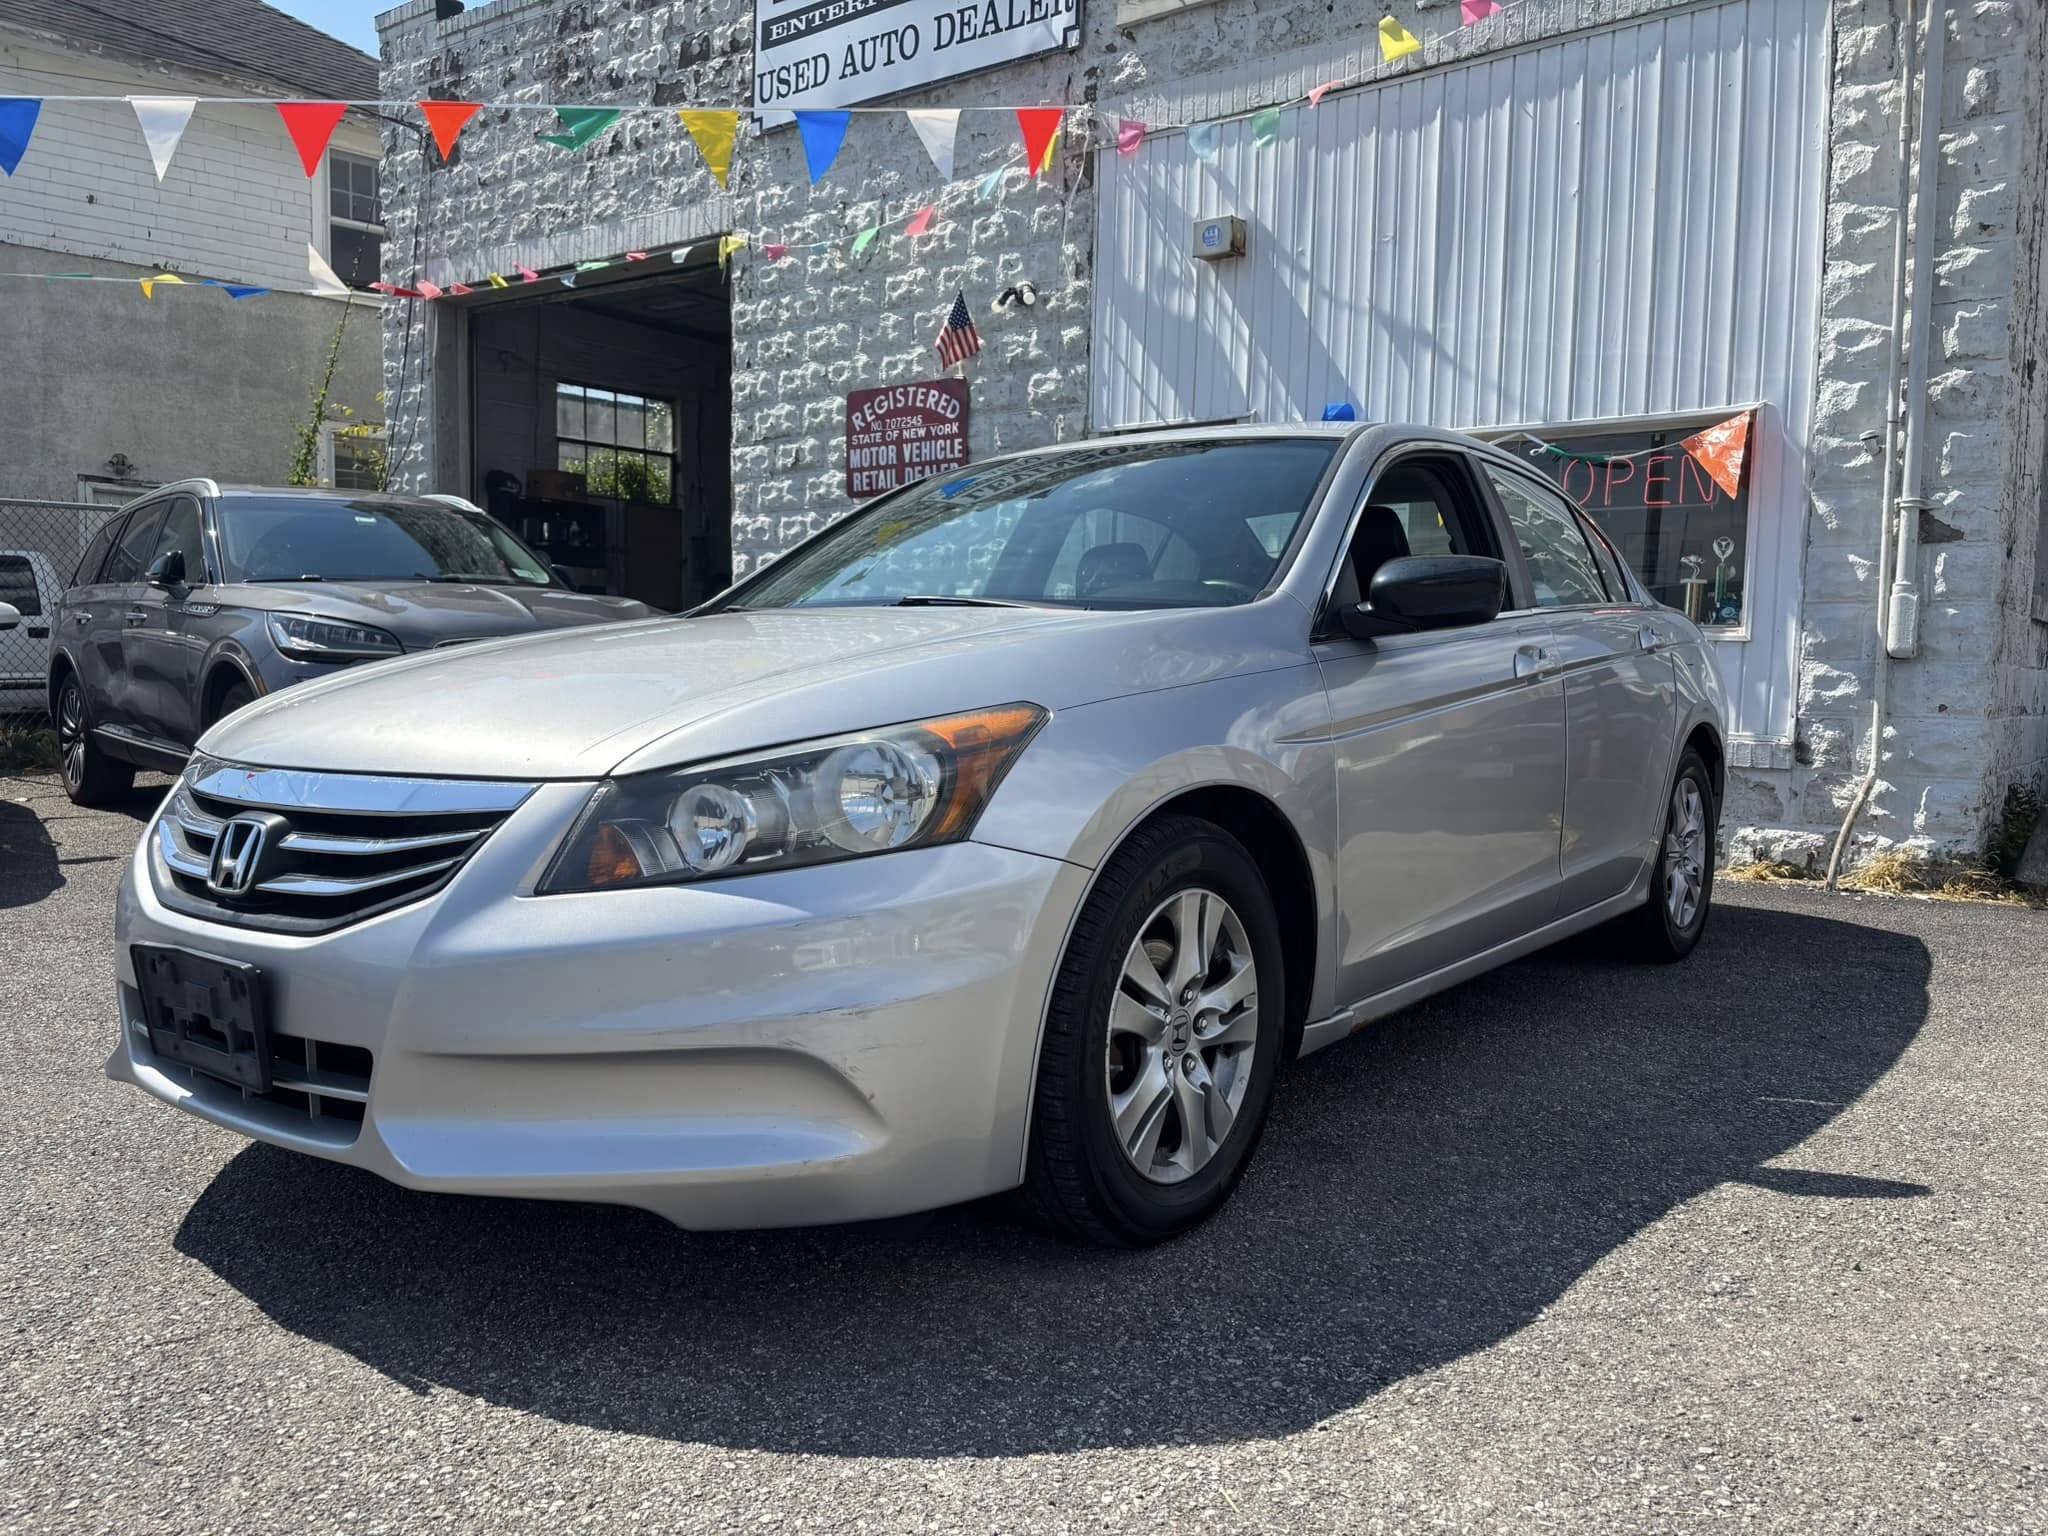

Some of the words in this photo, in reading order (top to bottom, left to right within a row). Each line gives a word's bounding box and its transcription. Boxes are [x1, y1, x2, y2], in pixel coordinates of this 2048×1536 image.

[757, 53, 830, 104] USED
[839, 24, 920, 79] AUTO
[851, 386, 960, 431] REGISTERED
[885, 414, 923, 430] 7072545
[851, 432, 882, 445] STATE
[885, 430, 900, 441] OF
[902, 427, 927, 439] NEW
[930, 422, 959, 436] YORK
[850, 445, 897, 469] MOTOR
[903, 438, 963, 463] VEHICLE
[853, 468, 899, 492] RETAIL
[1563, 455, 1714, 507] OPEN
